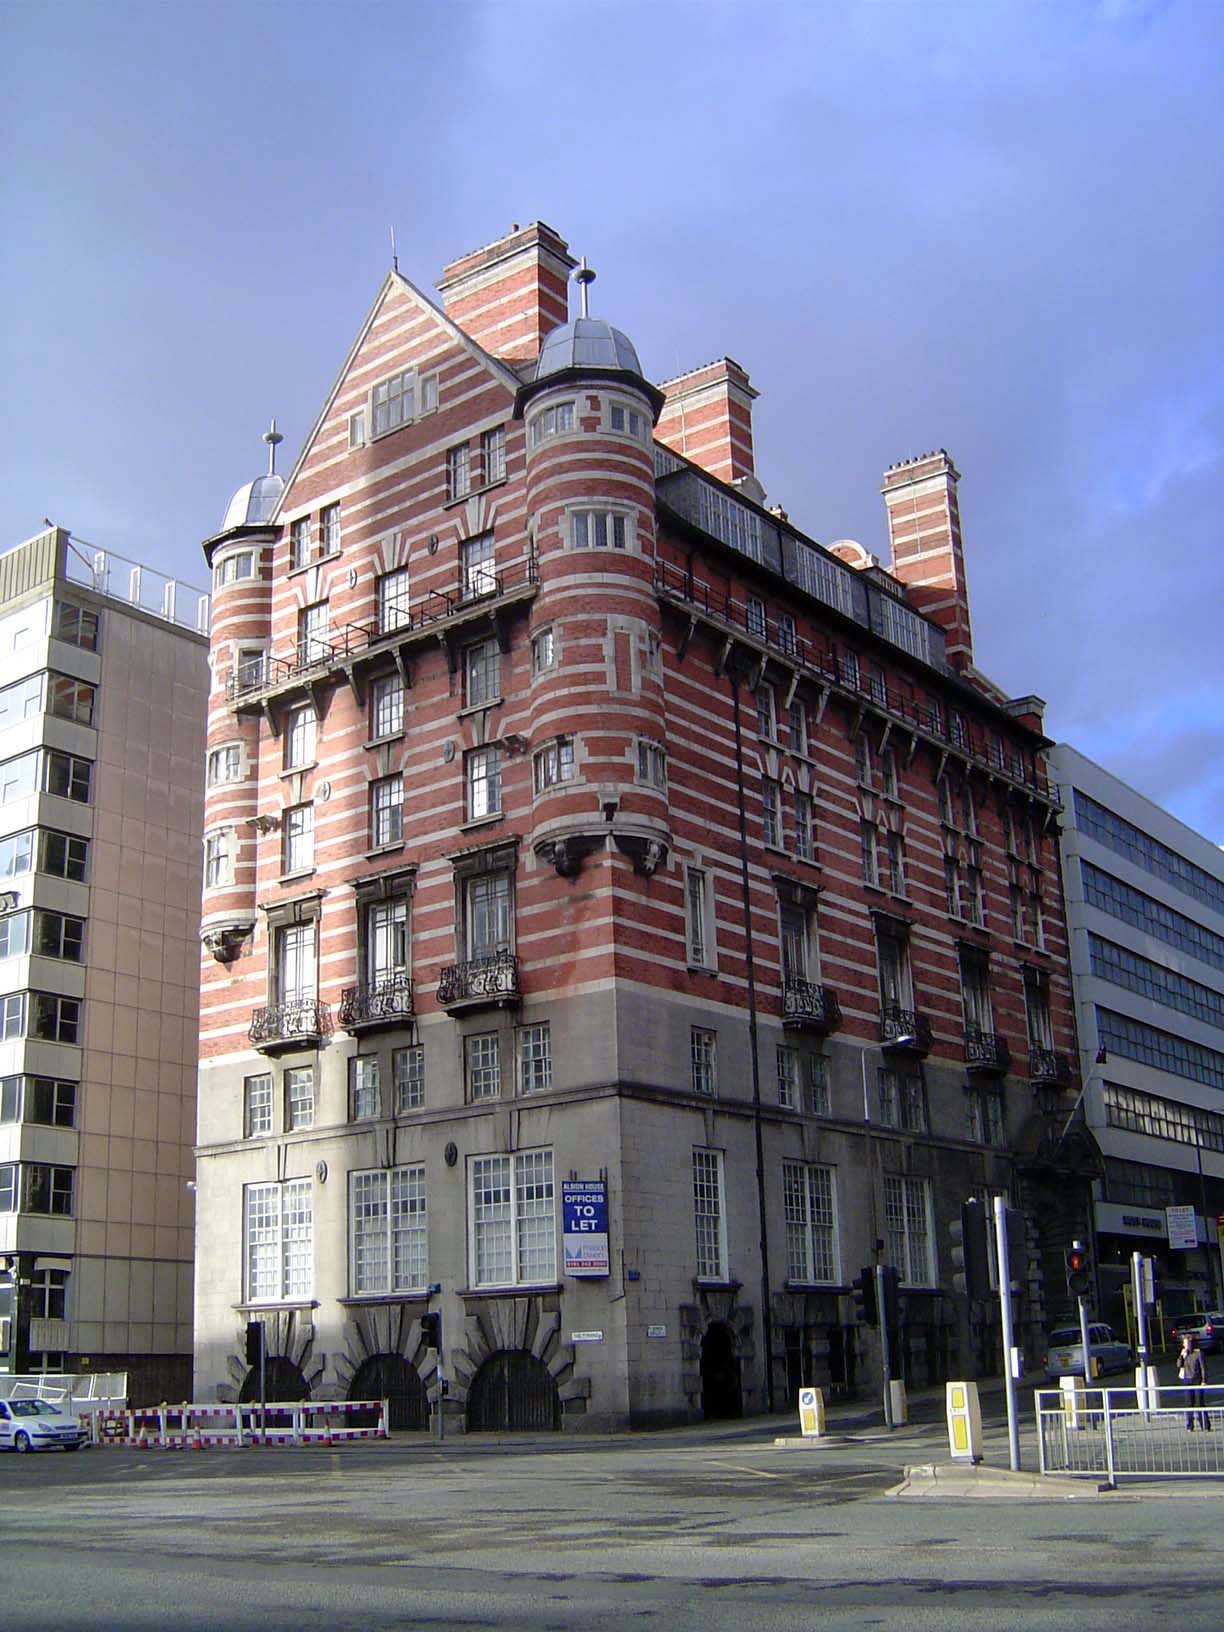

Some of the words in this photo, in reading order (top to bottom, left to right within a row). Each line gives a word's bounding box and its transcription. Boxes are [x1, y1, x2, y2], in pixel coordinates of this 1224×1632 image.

[564, 1194, 604, 1203] OFFICES
[574, 1205, 595, 1217] TO
[571, 1219, 598, 1231] LET
